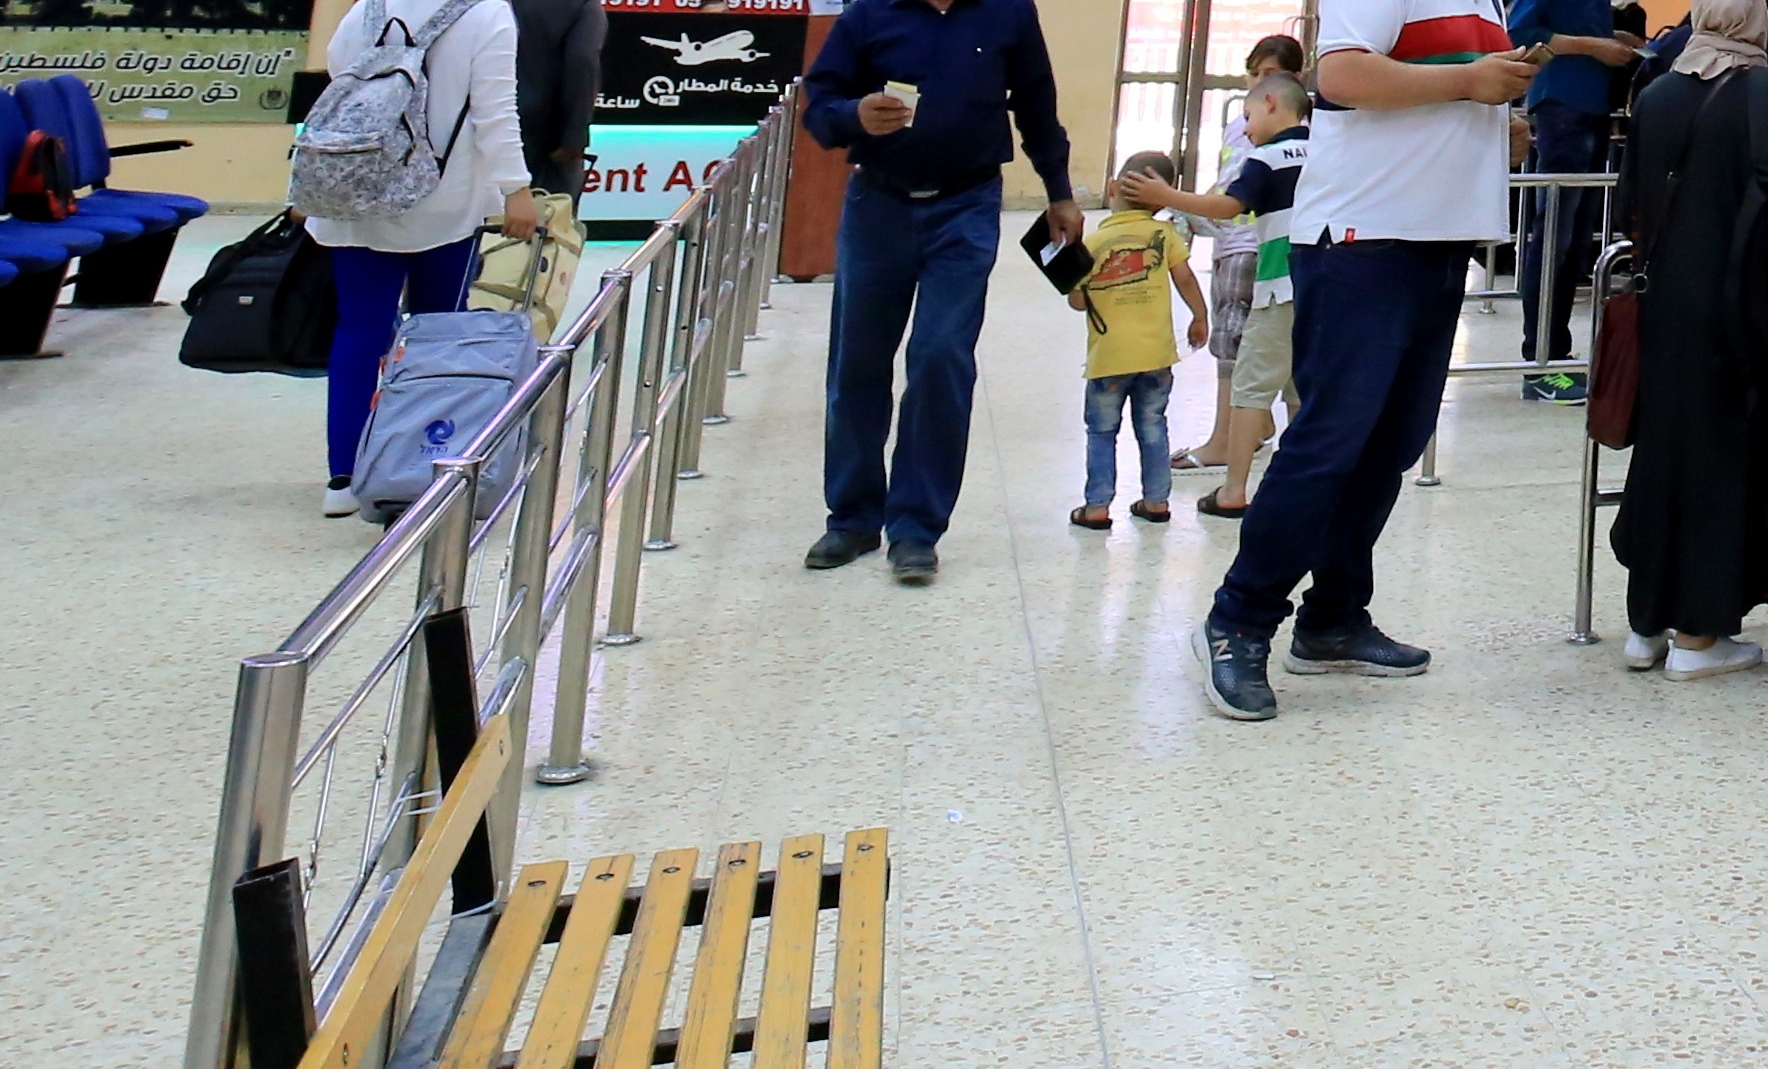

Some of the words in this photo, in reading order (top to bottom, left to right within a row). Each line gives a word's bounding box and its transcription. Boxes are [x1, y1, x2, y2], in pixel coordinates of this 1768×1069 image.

[0, 50, 107, 74] فلسطين
[115, 50, 173, 76] دولة
[179, 51, 252, 78] إقامة
[109, 81, 196, 104] مقدس
[201, 84, 241, 103] حق
[676, 77, 730, 94] المطار
[731, 77, 779, 94] خدمة
[593, 93, 642, 109] ساعة
[581, 162, 648, 193] ent
